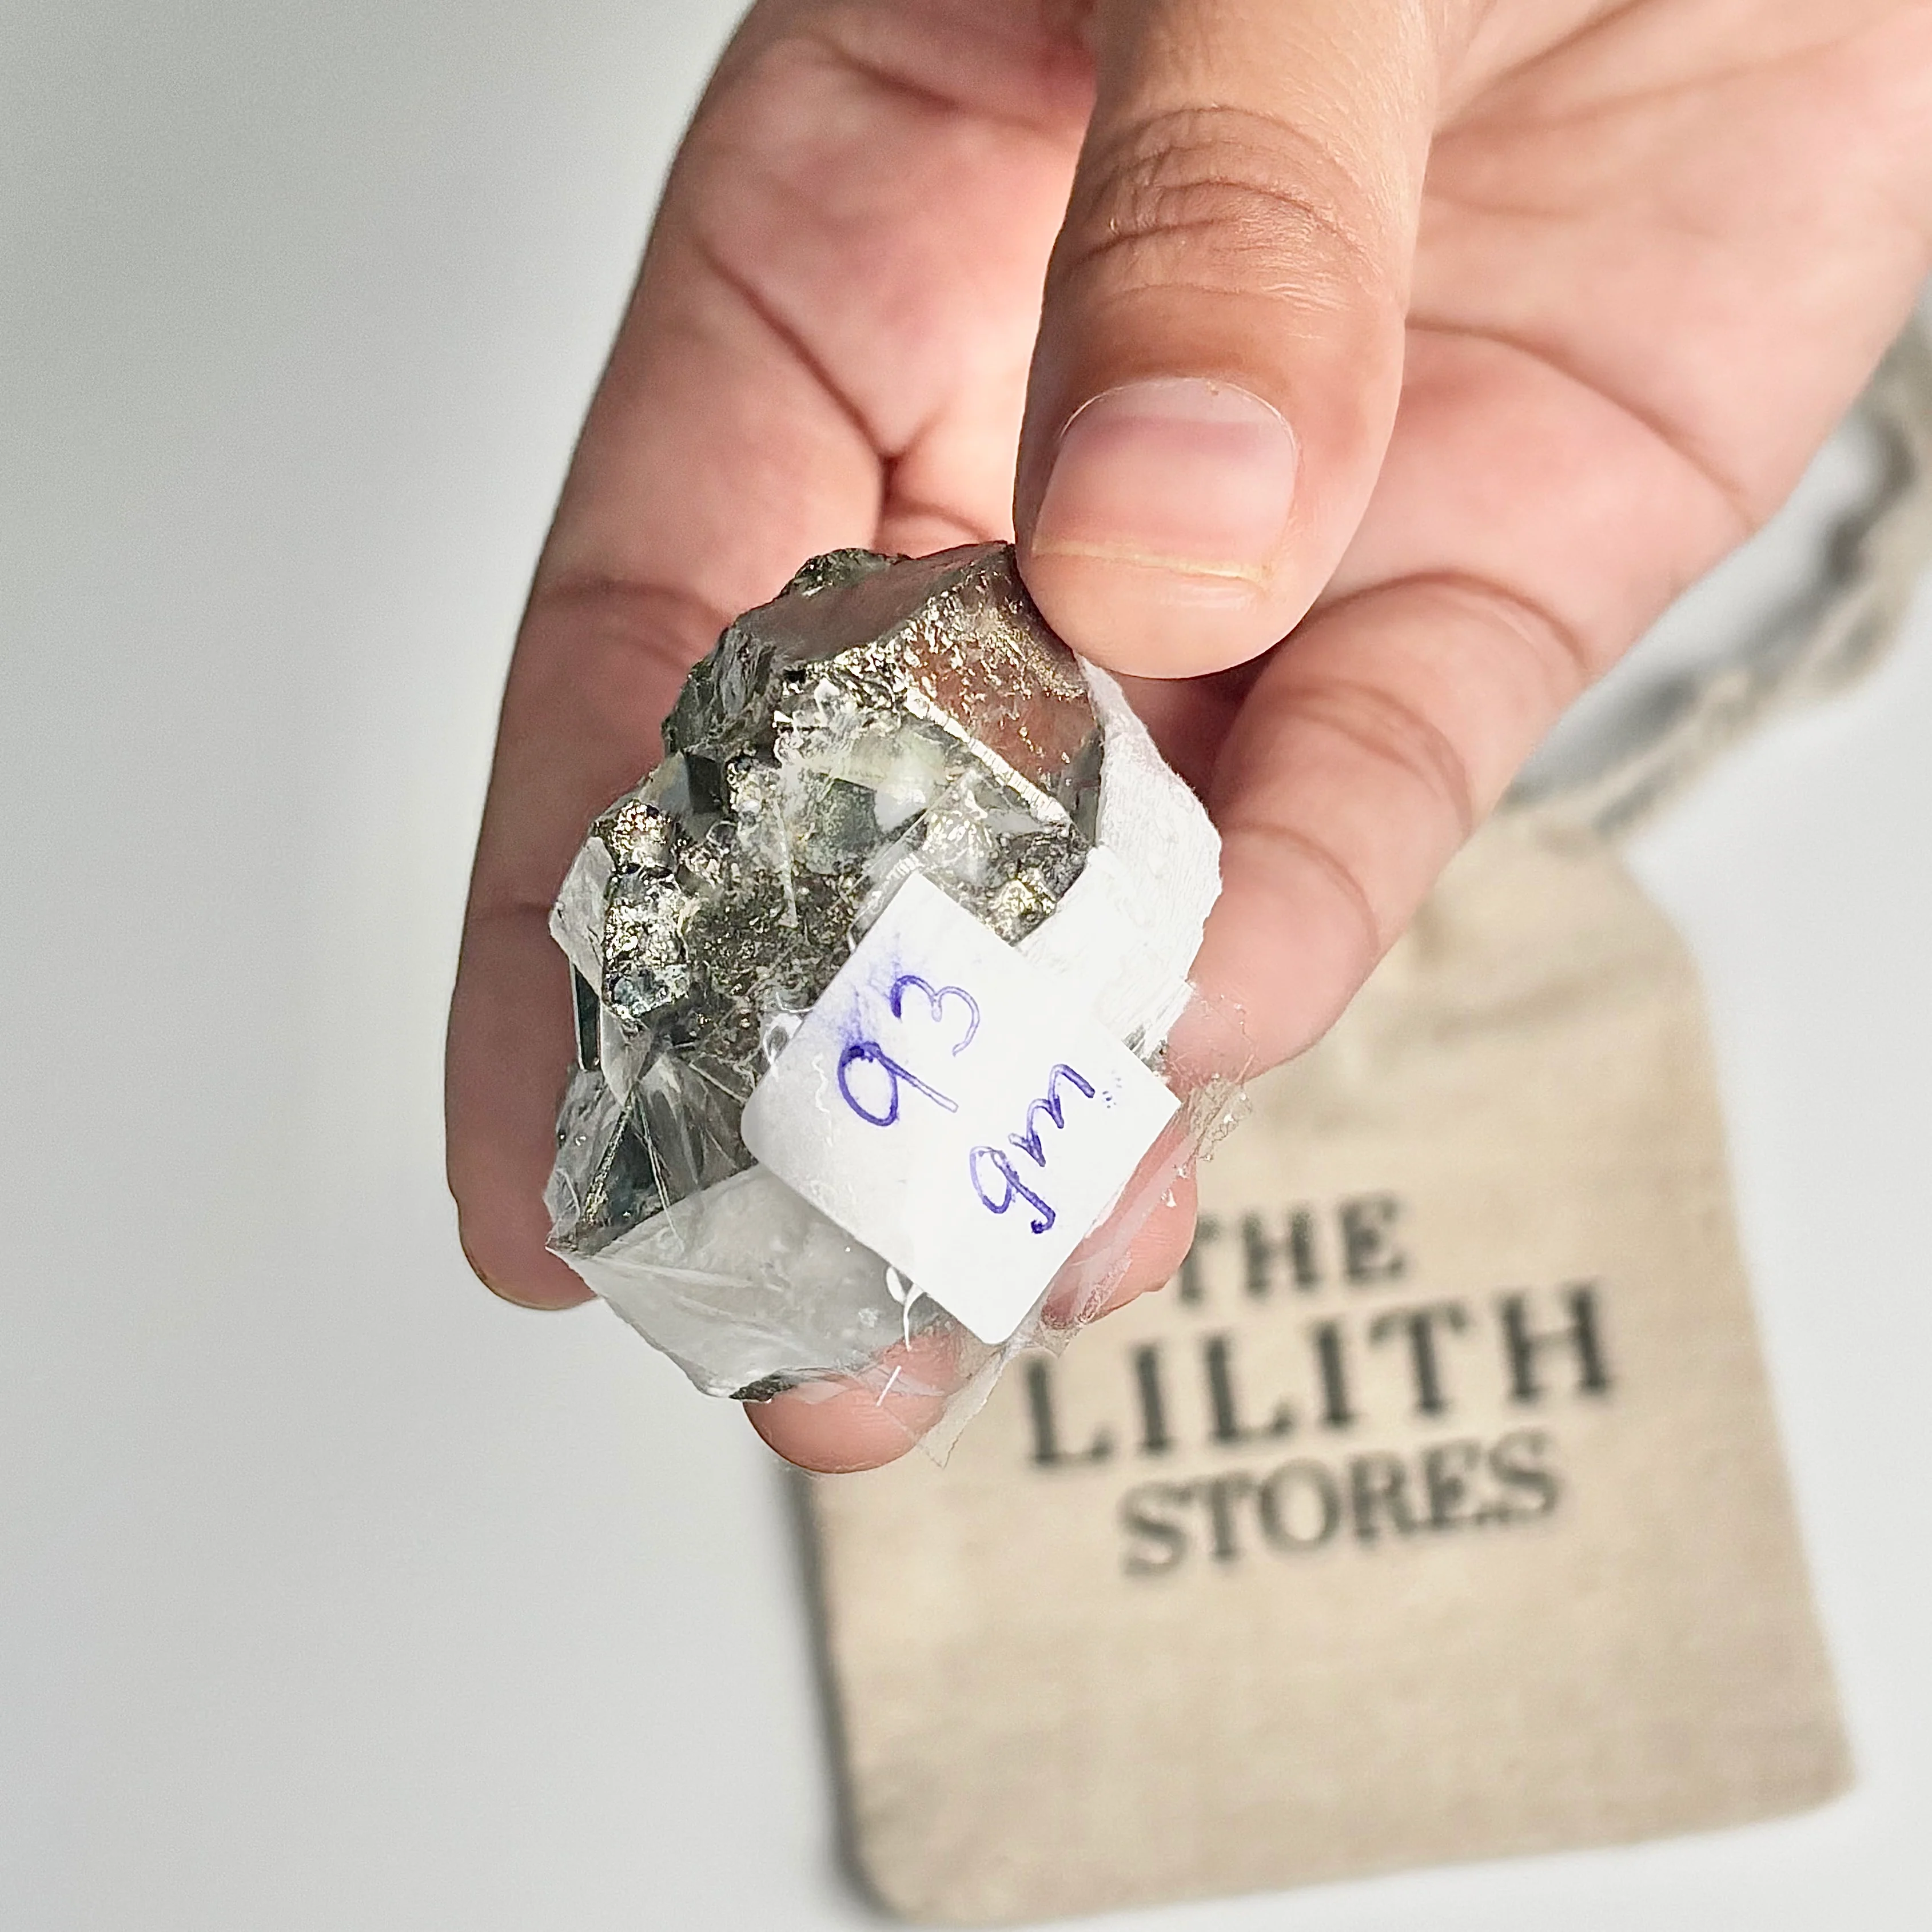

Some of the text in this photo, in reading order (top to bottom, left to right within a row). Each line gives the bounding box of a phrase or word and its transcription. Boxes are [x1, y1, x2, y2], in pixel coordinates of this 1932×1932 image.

[837, 974, 981, 1127] 93
[969, 1063, 1096, 1234] gm
[1177, 1192, 1405, 1305] THE
[1022, 1281, 1615, 1465] LILITH
[1119, 1427, 1567, 1576] STORES
